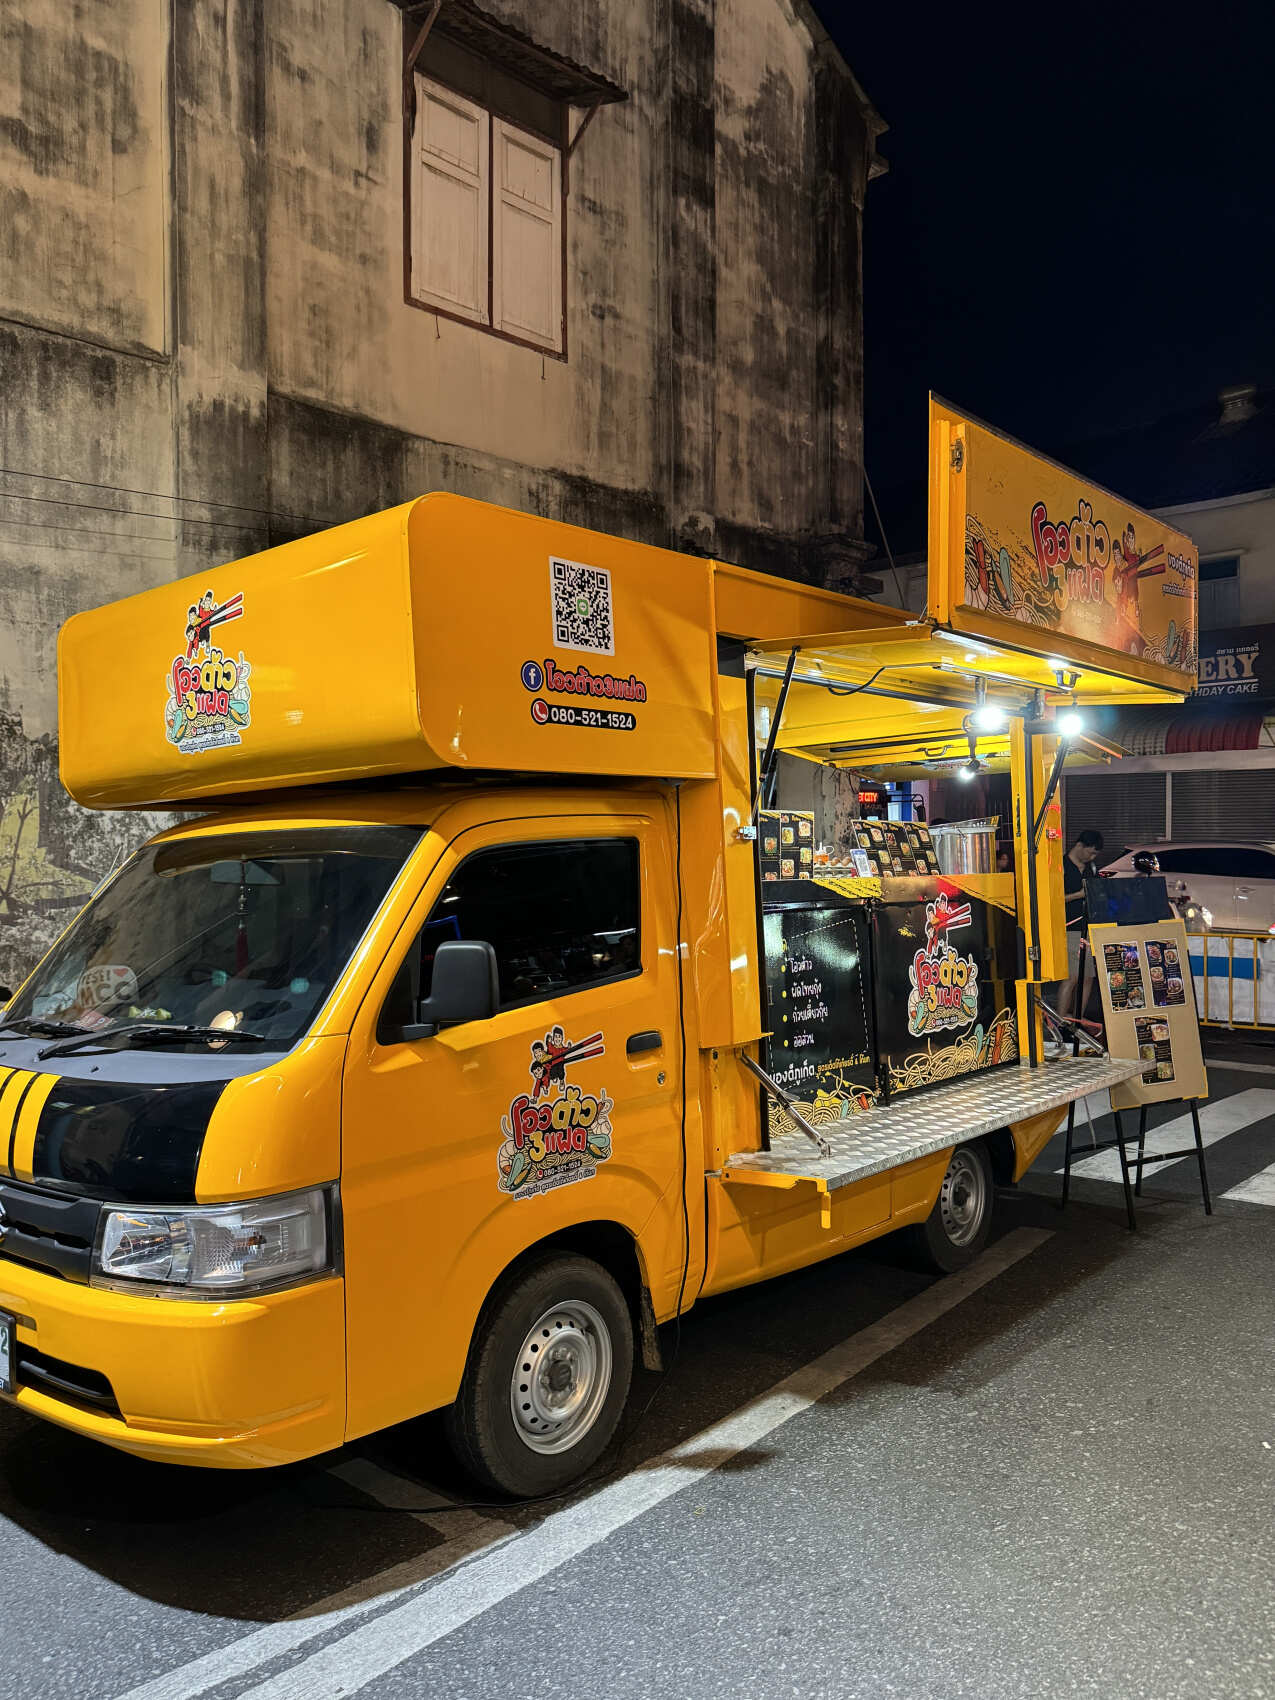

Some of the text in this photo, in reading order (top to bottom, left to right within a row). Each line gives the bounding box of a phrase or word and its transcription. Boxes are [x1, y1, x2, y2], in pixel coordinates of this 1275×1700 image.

[1227, 683, 1259, 695] CAKE
[551, 707, 633, 729] 080-521-1524
[865, 792, 878, 803] CITY
